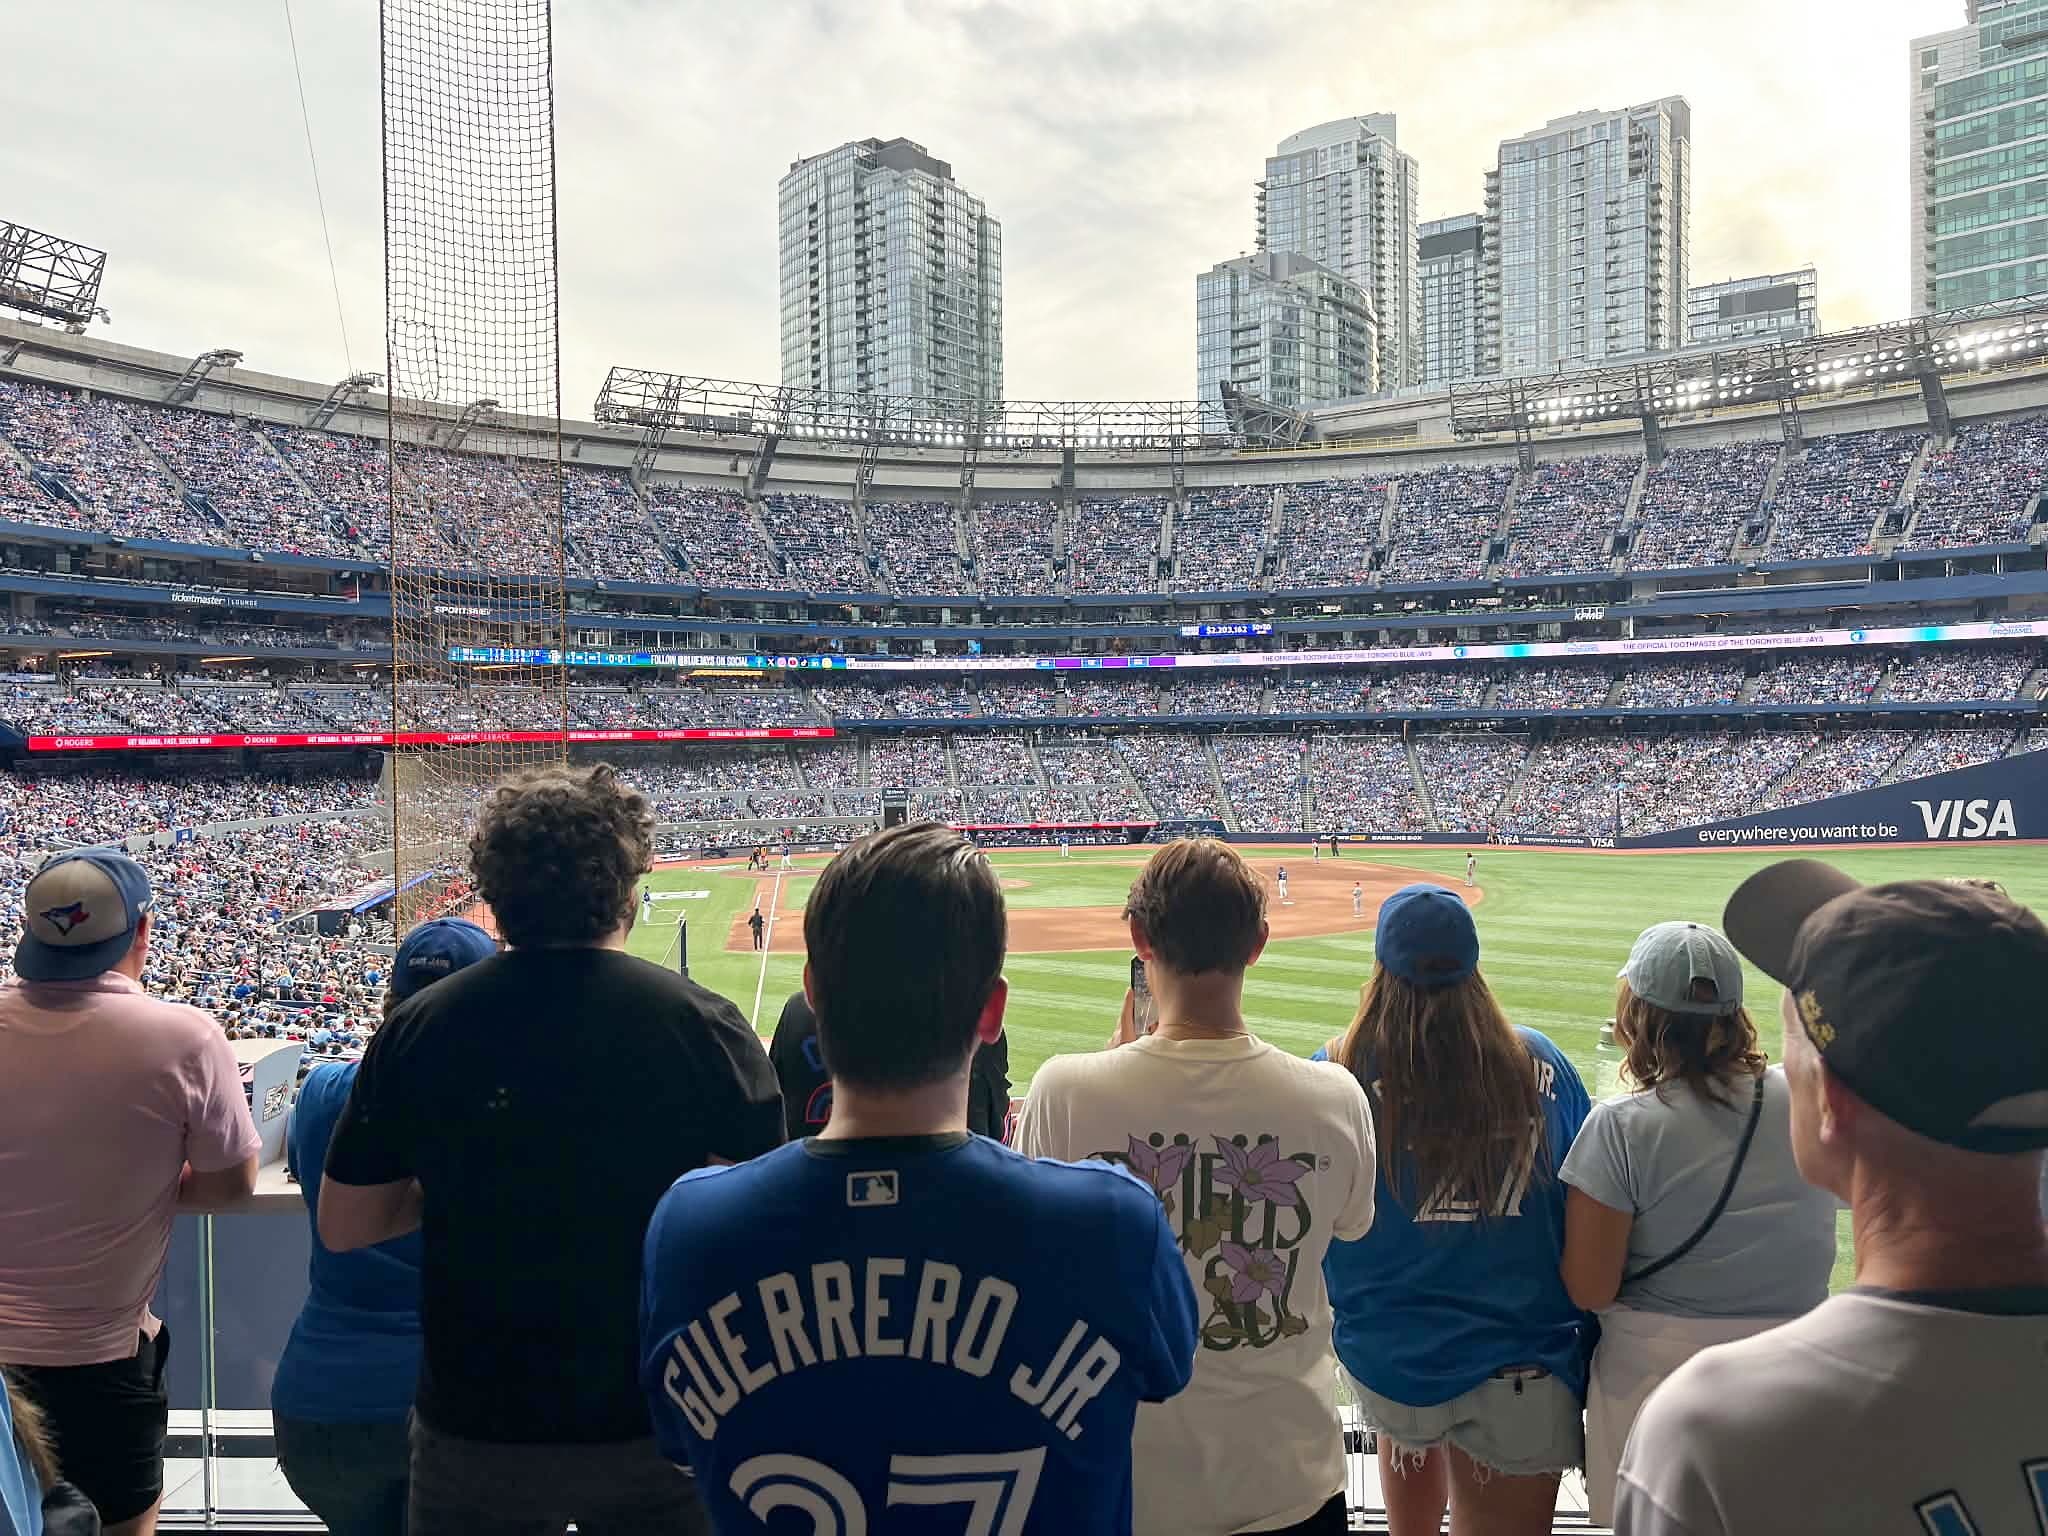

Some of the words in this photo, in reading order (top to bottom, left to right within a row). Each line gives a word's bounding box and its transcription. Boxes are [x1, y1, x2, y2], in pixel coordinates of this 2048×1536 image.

[172, 592, 225, 605] ticketmaster
[651, 654, 677, 664] FOLLOW
[1912, 799, 2017, 839] VISA
[1699, 826, 1787, 843] everywhere
[1790, 827, 1818, 842] you
[1820, 825, 1858, 838] want
[1858, 824, 1876, 837] to
[1879, 822, 1898, 836] be
[1590, 837, 1615, 847] VISA
[663, 1257, 1019, 1440] GUERRERO
[1010, 1319, 1121, 1440] JR.
